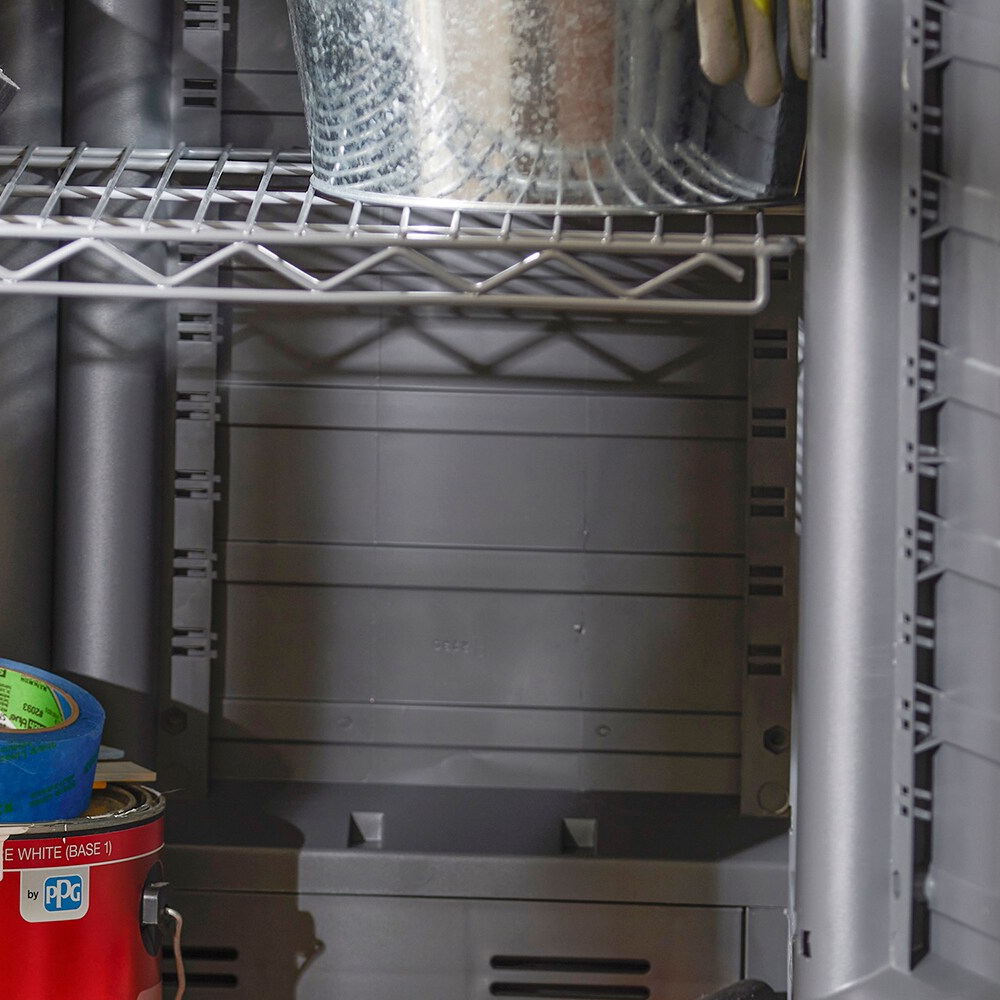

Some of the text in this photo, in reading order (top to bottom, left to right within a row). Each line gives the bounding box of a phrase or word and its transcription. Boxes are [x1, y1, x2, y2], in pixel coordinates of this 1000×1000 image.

[18, 846, 62, 860] WHITE
[65, 842, 101, 861] (BASE
[104, 840, 112, 856] 1)
[27, 890, 39, 900] by
